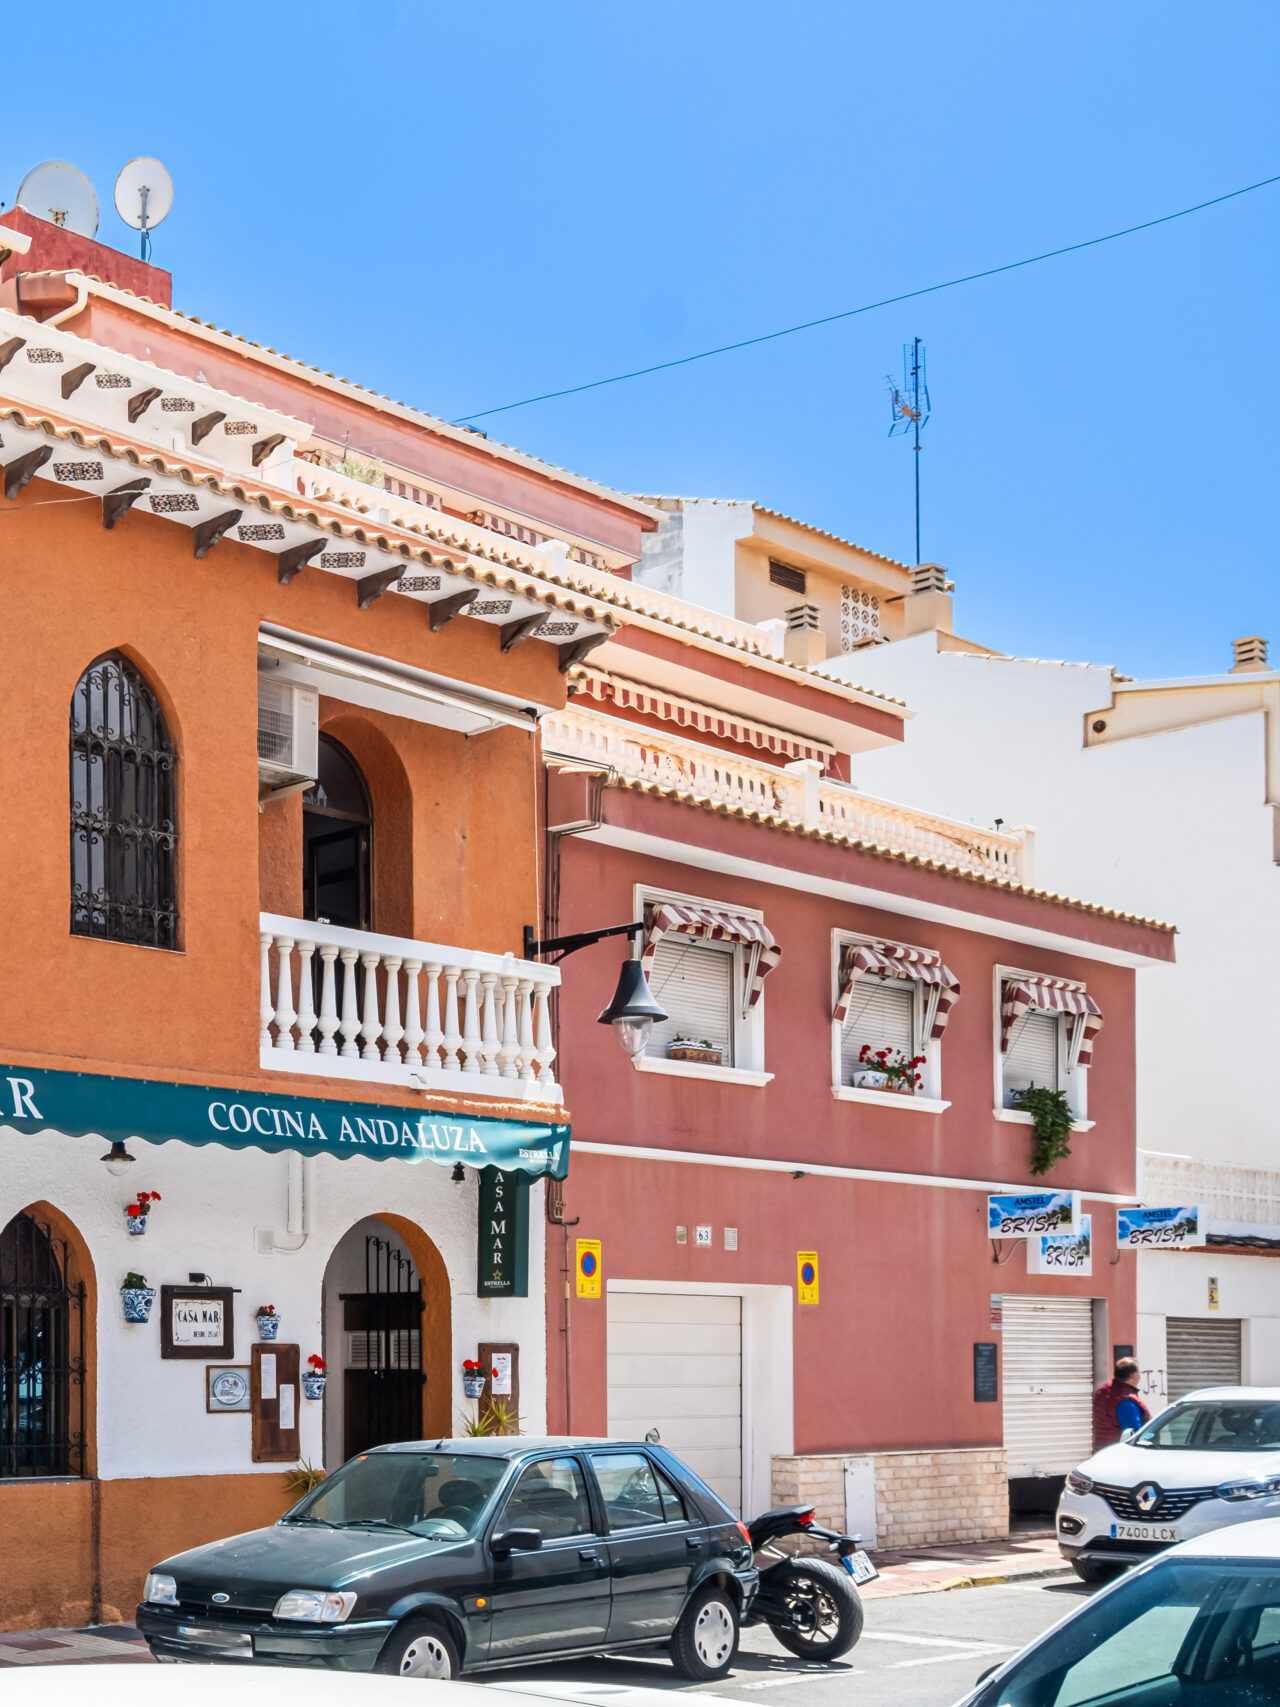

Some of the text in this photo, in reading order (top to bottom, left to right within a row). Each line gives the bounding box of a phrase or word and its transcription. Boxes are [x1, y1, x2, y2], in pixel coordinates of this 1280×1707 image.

[208, 1102, 487, 1153] COCINA ANDALUZA
[490, 1171, 507, 1264] ASA MAR
[1000, 1214, 1062, 1233] BRISA
[699, 1230, 709, 1241] 63
[1129, 1225, 1188, 1244] BRISA
[1046, 1245, 1086, 1266] BRISA
[178, 1310, 219, 1323] CASA MAR
[1118, 1526, 1176, 1541] 7400 LCX
